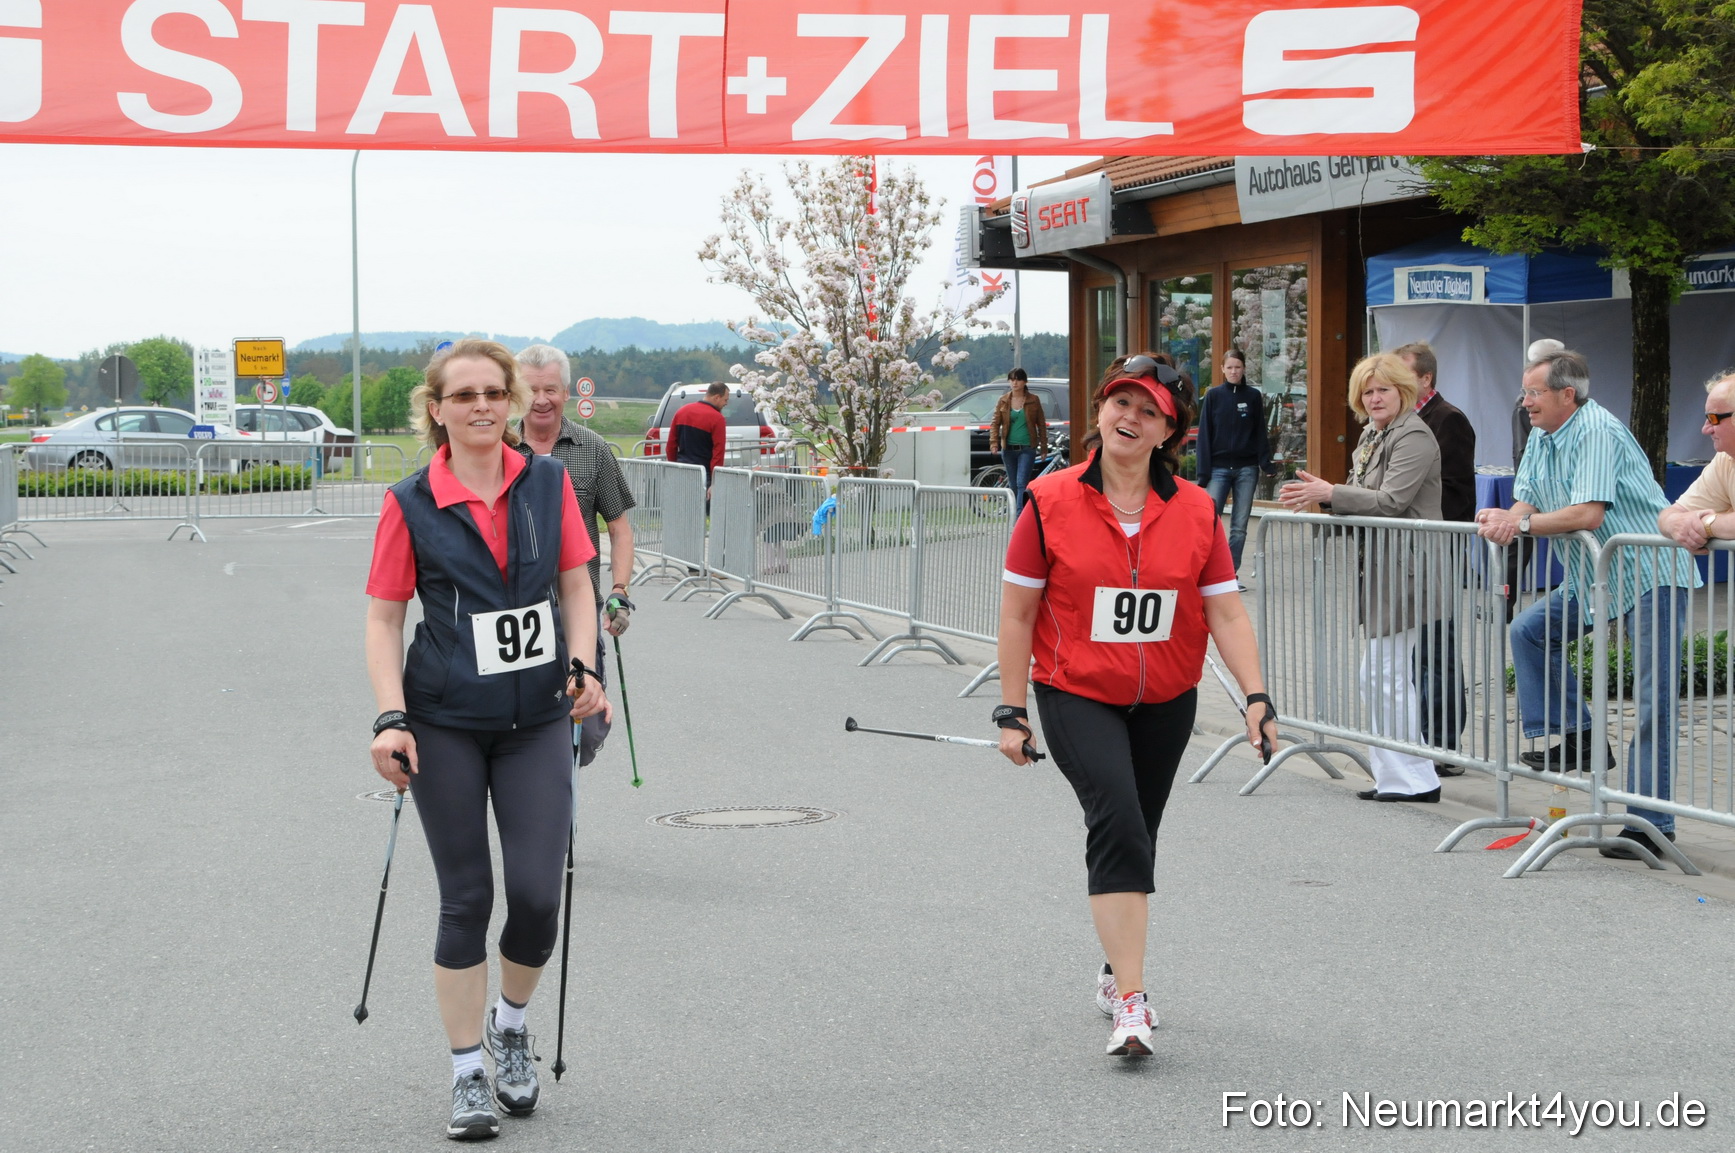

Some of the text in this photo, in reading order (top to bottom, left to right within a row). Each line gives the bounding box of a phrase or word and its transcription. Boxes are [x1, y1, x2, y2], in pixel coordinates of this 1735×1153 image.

[1249, 158, 1322, 196] Autohaus
[1038, 197, 1090, 231] SEAT
[240, 353, 280, 362] Neumarkt
[581, 383, 591, 392] 60
[1113, 591, 1162, 635] 90
[496, 609, 544, 663] 92
